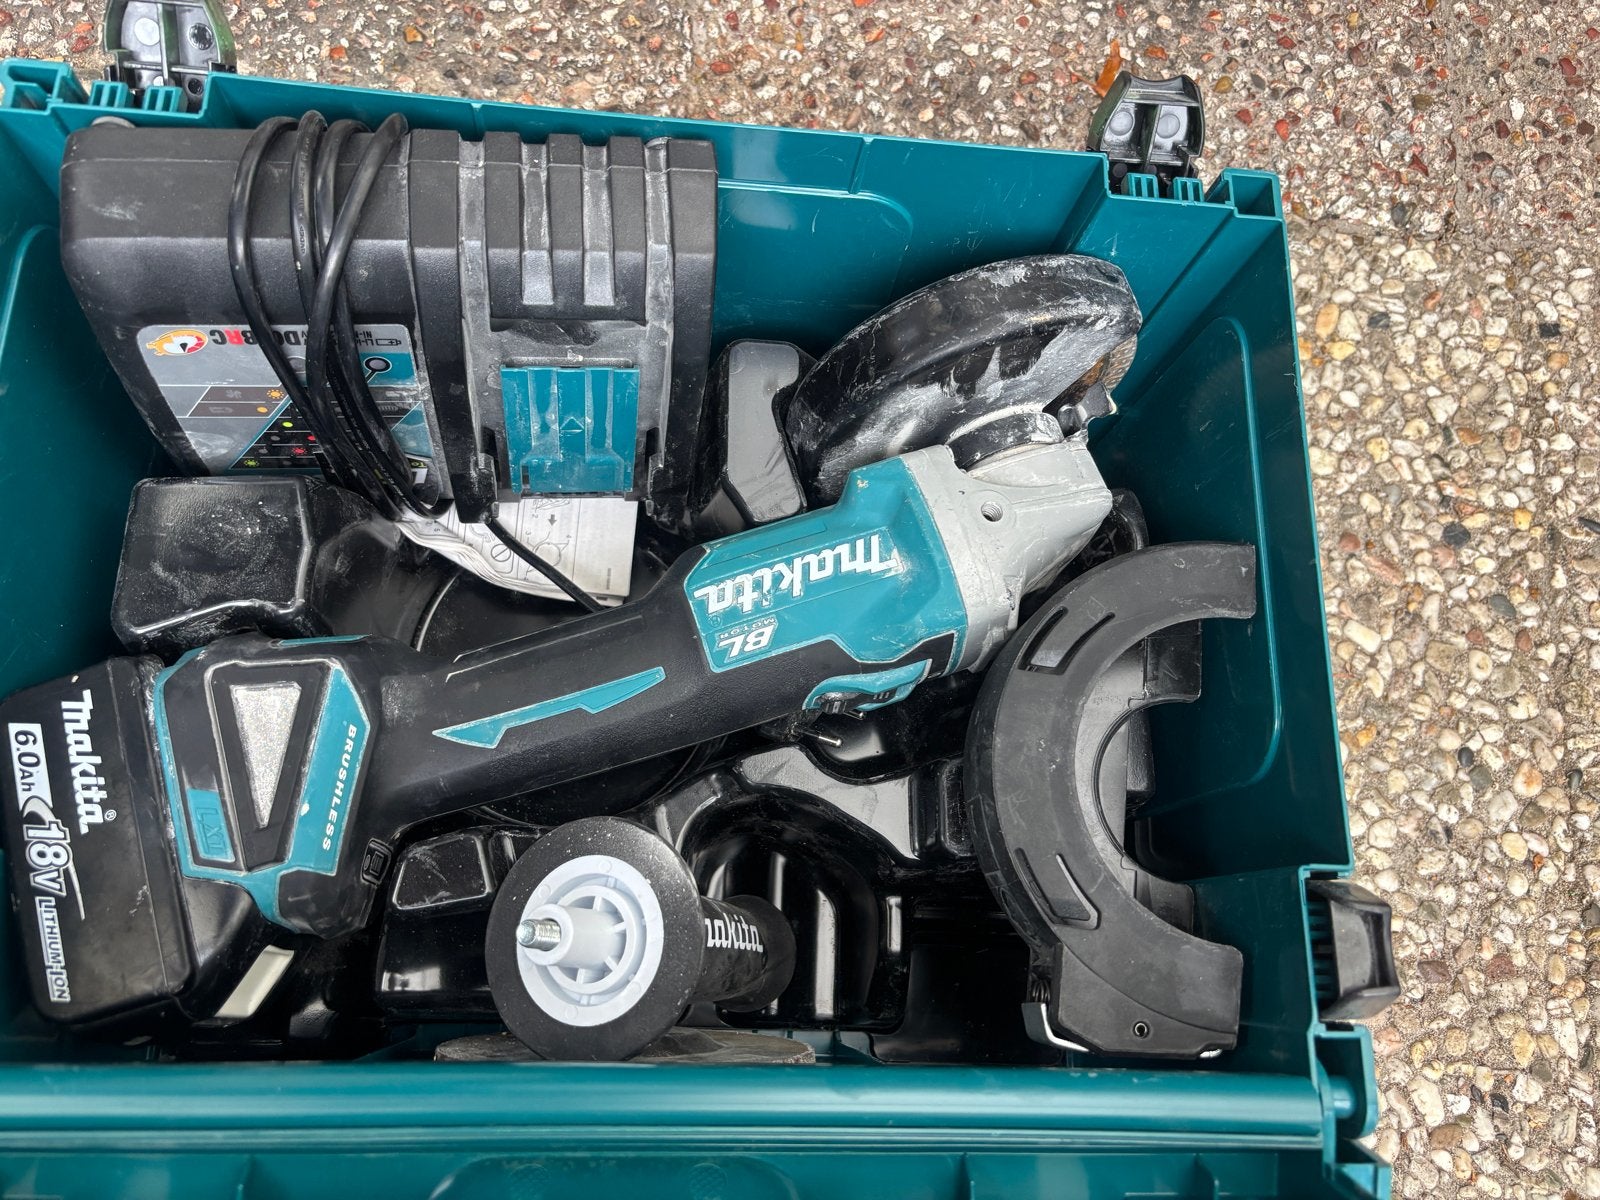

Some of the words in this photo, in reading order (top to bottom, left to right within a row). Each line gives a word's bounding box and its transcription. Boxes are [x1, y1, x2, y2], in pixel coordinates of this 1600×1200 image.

[718, 622, 778, 659] BL
[719, 617, 776, 640] MOTOR
[14, 729, 41, 792] 6.0Ah
[322, 724, 357, 851] BRUSHLESS
[195, 807, 226, 853] LXT
[23, 819, 73, 897] 18V
